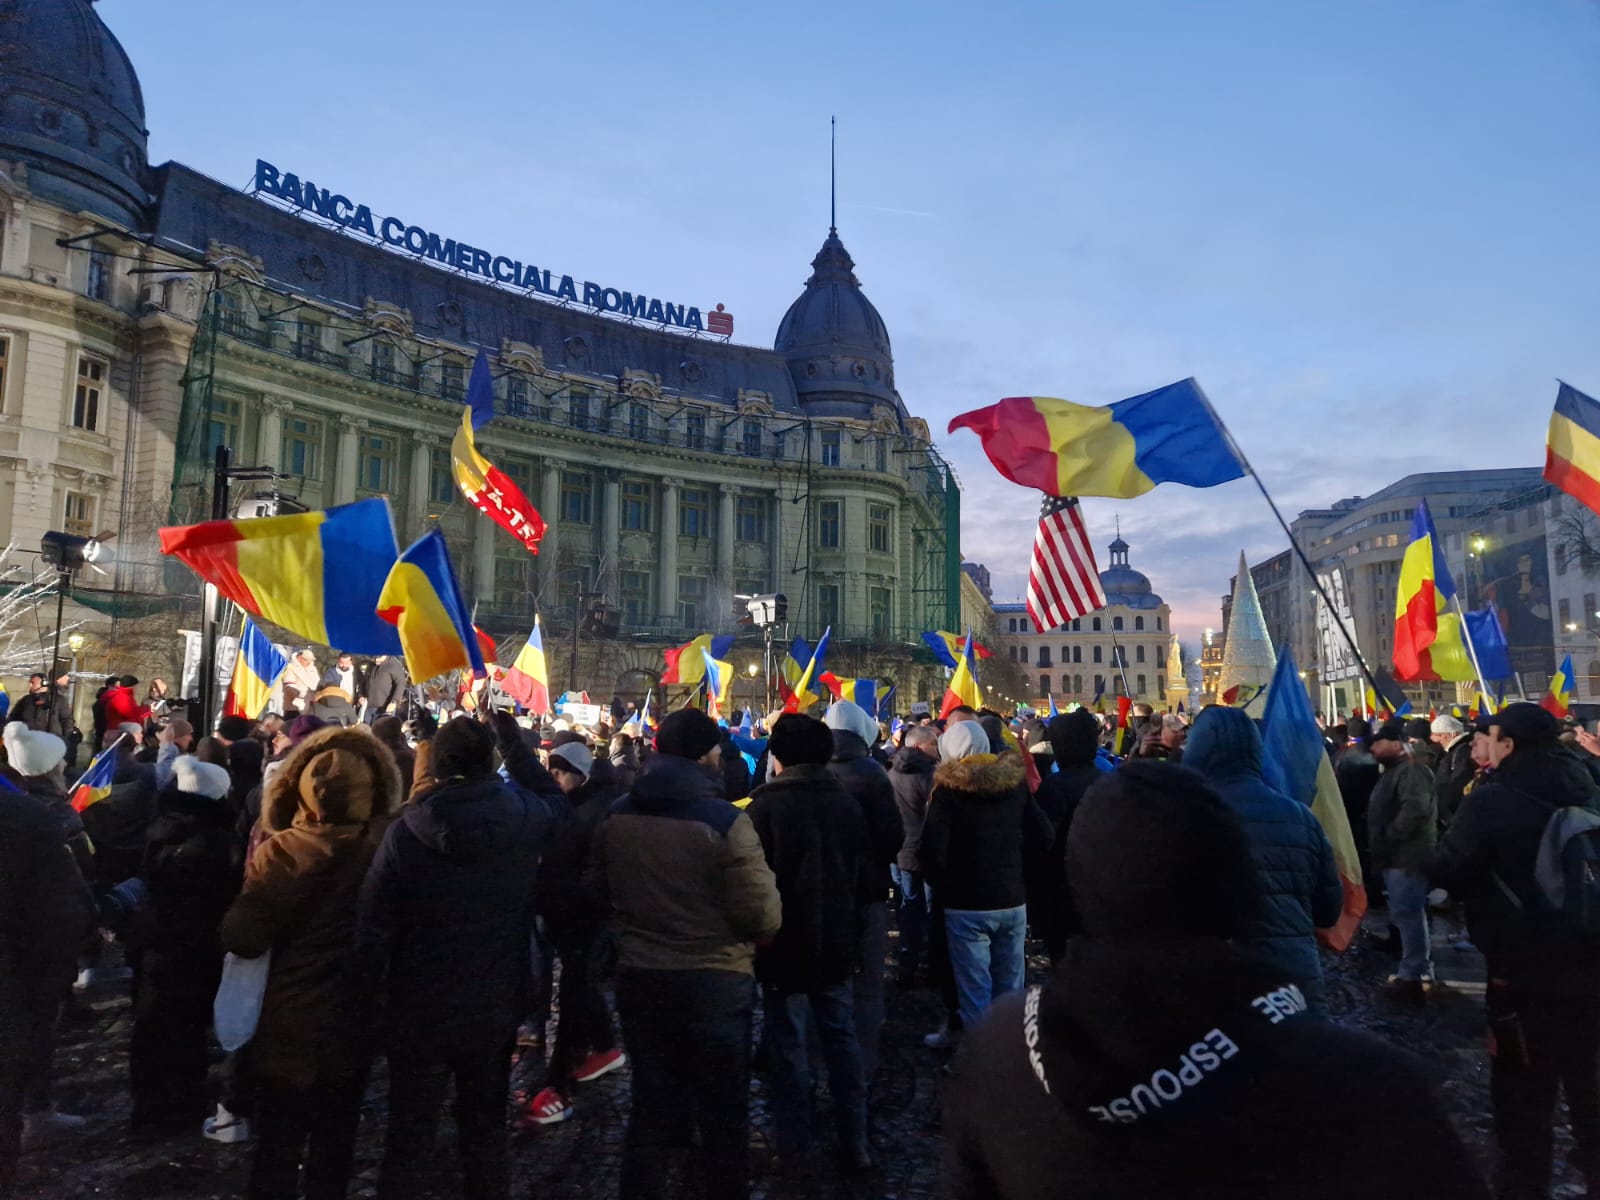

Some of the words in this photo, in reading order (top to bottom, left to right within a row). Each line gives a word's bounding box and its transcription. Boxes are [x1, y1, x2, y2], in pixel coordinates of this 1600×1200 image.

[255, 158, 375, 238] BANCA
[381, 216, 578, 303] COMERCIALA
[583, 281, 704, 331] ROMANA
